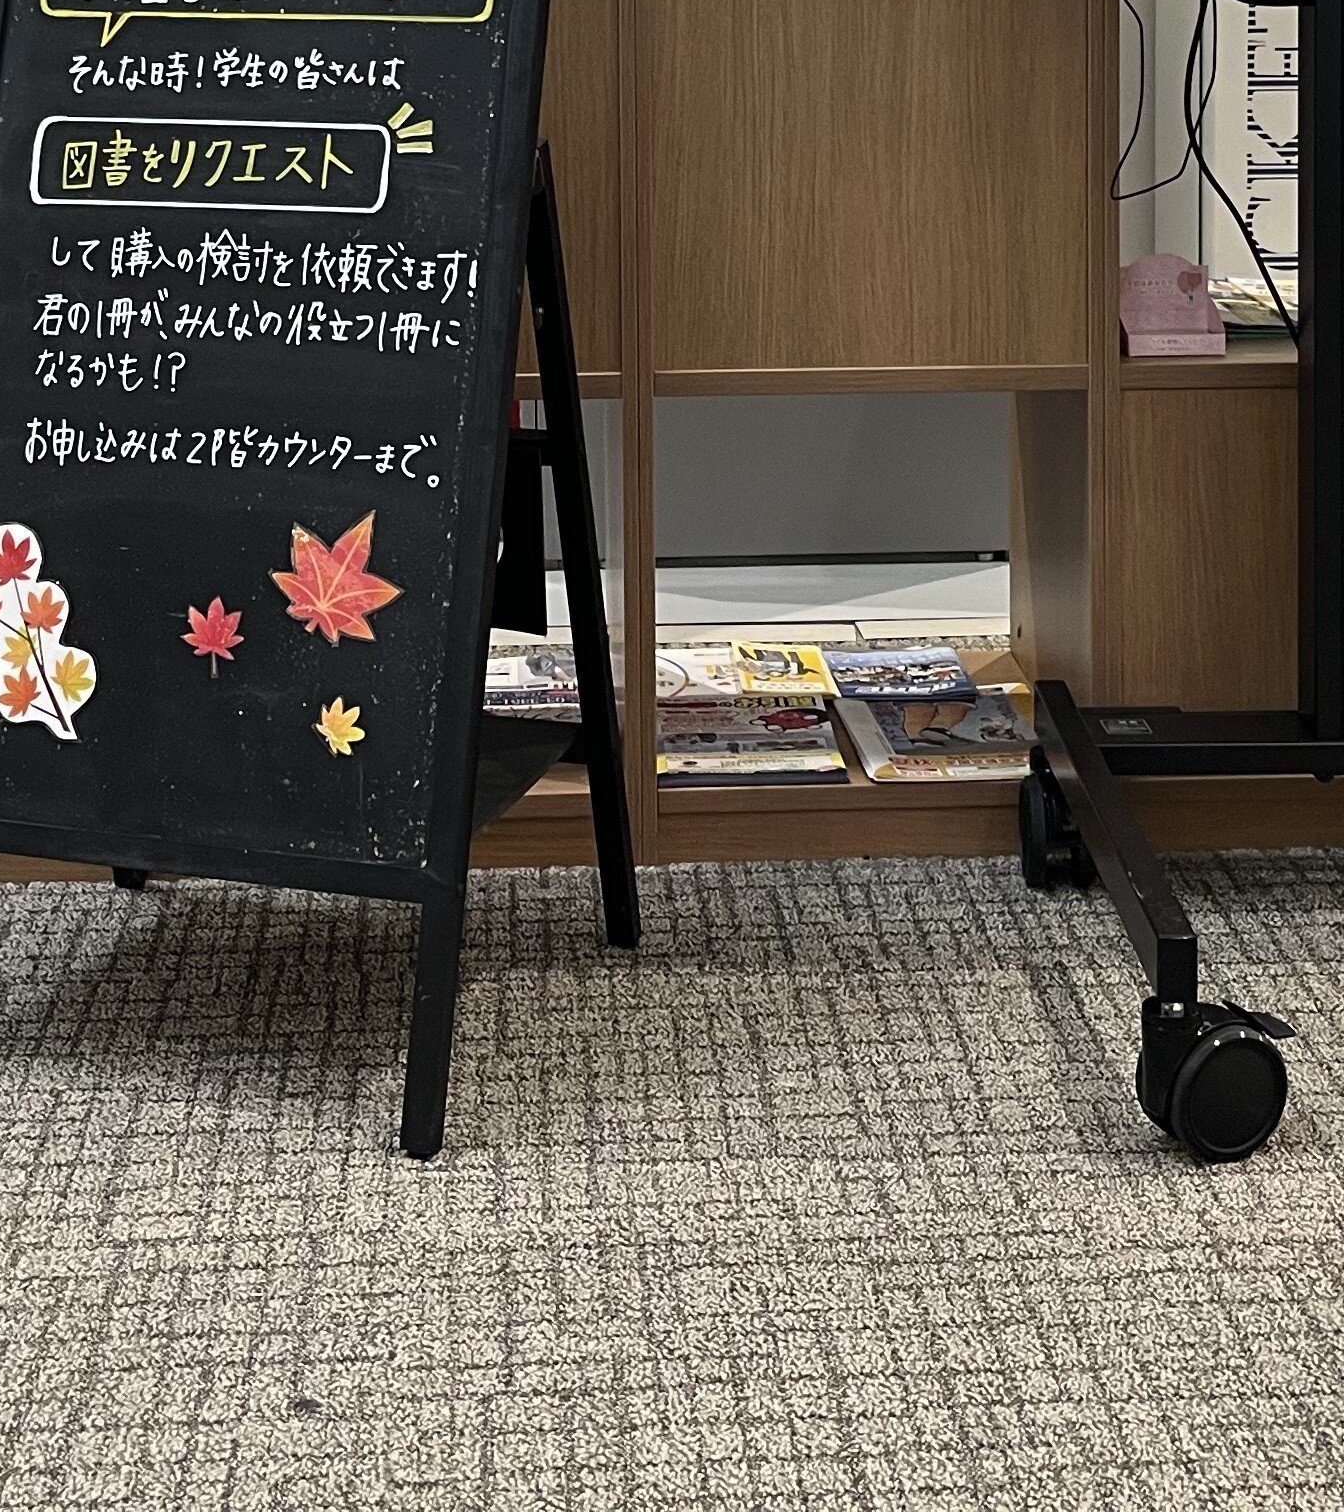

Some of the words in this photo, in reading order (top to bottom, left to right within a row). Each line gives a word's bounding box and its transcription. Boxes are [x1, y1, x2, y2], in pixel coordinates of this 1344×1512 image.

[67, 46, 406, 93] そんな時!学生の皆さんは
[62, 129, 354, 189] 図書をリクエスト
[50, 226, 480, 304] して購入の検討を依頼できます!
[34, 351, 187, 392] なるかも!?
[25, 417, 441, 489] お申し込みは2階カウンターまで。
